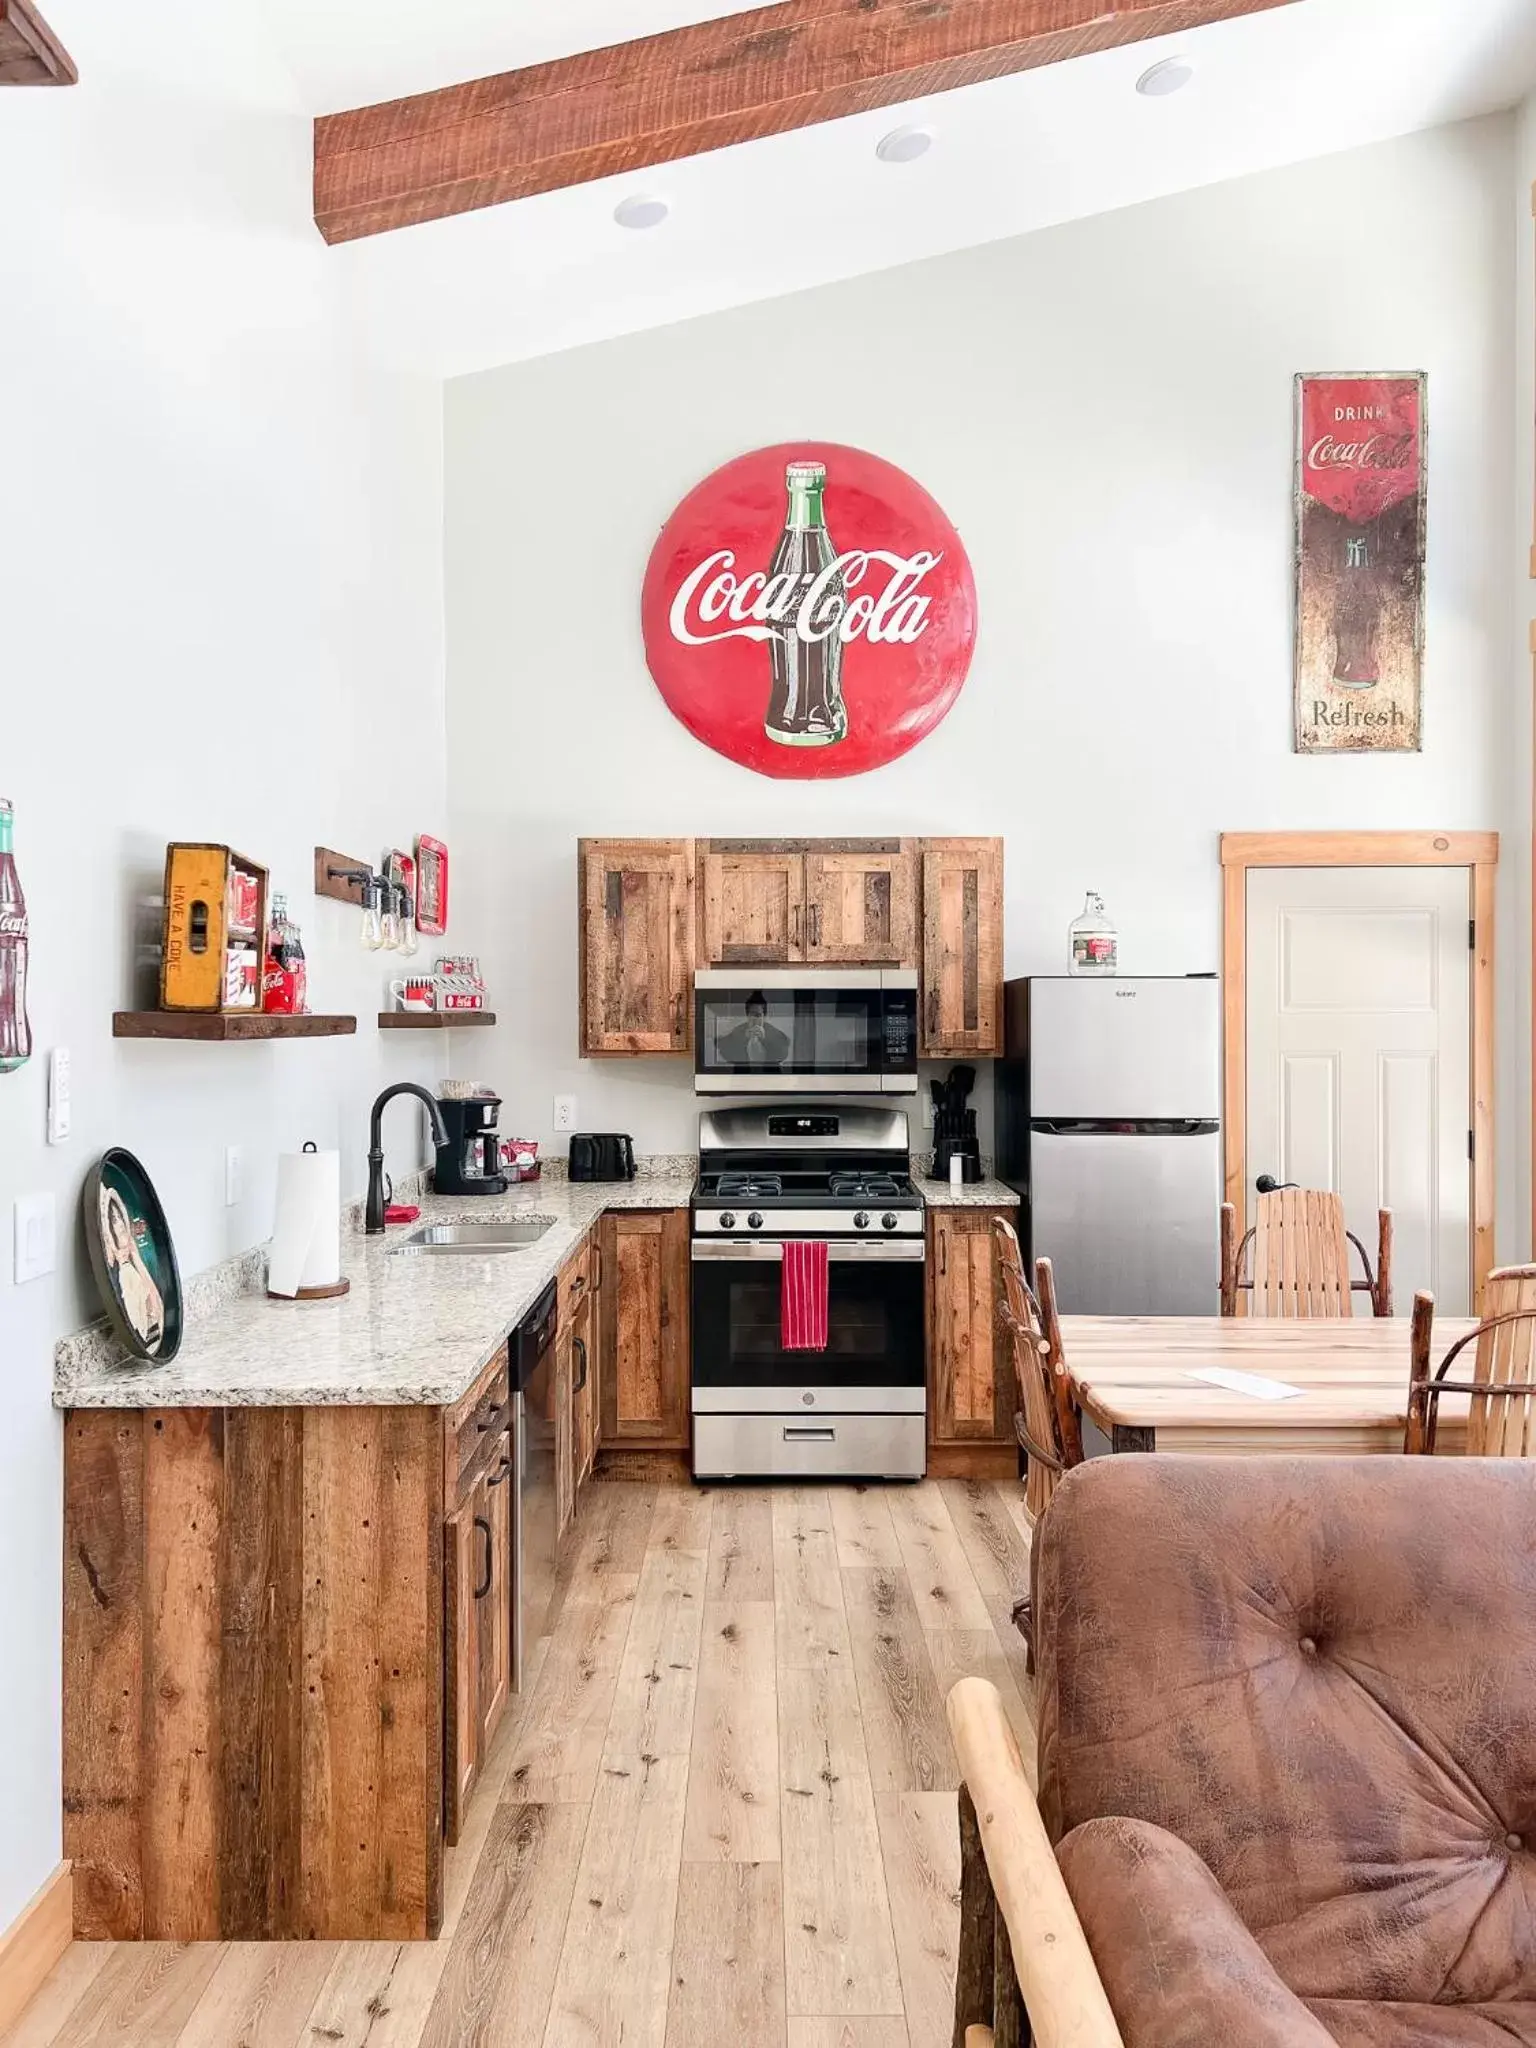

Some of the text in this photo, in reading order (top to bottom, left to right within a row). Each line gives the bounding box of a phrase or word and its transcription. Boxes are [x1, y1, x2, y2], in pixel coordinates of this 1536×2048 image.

[668, 549, 944, 646] Coca-Cola
[1312, 700, 1405, 727] Refresh
[172, 885, 186, 919] HAVE
[169, 939, 183, 971] COKE
